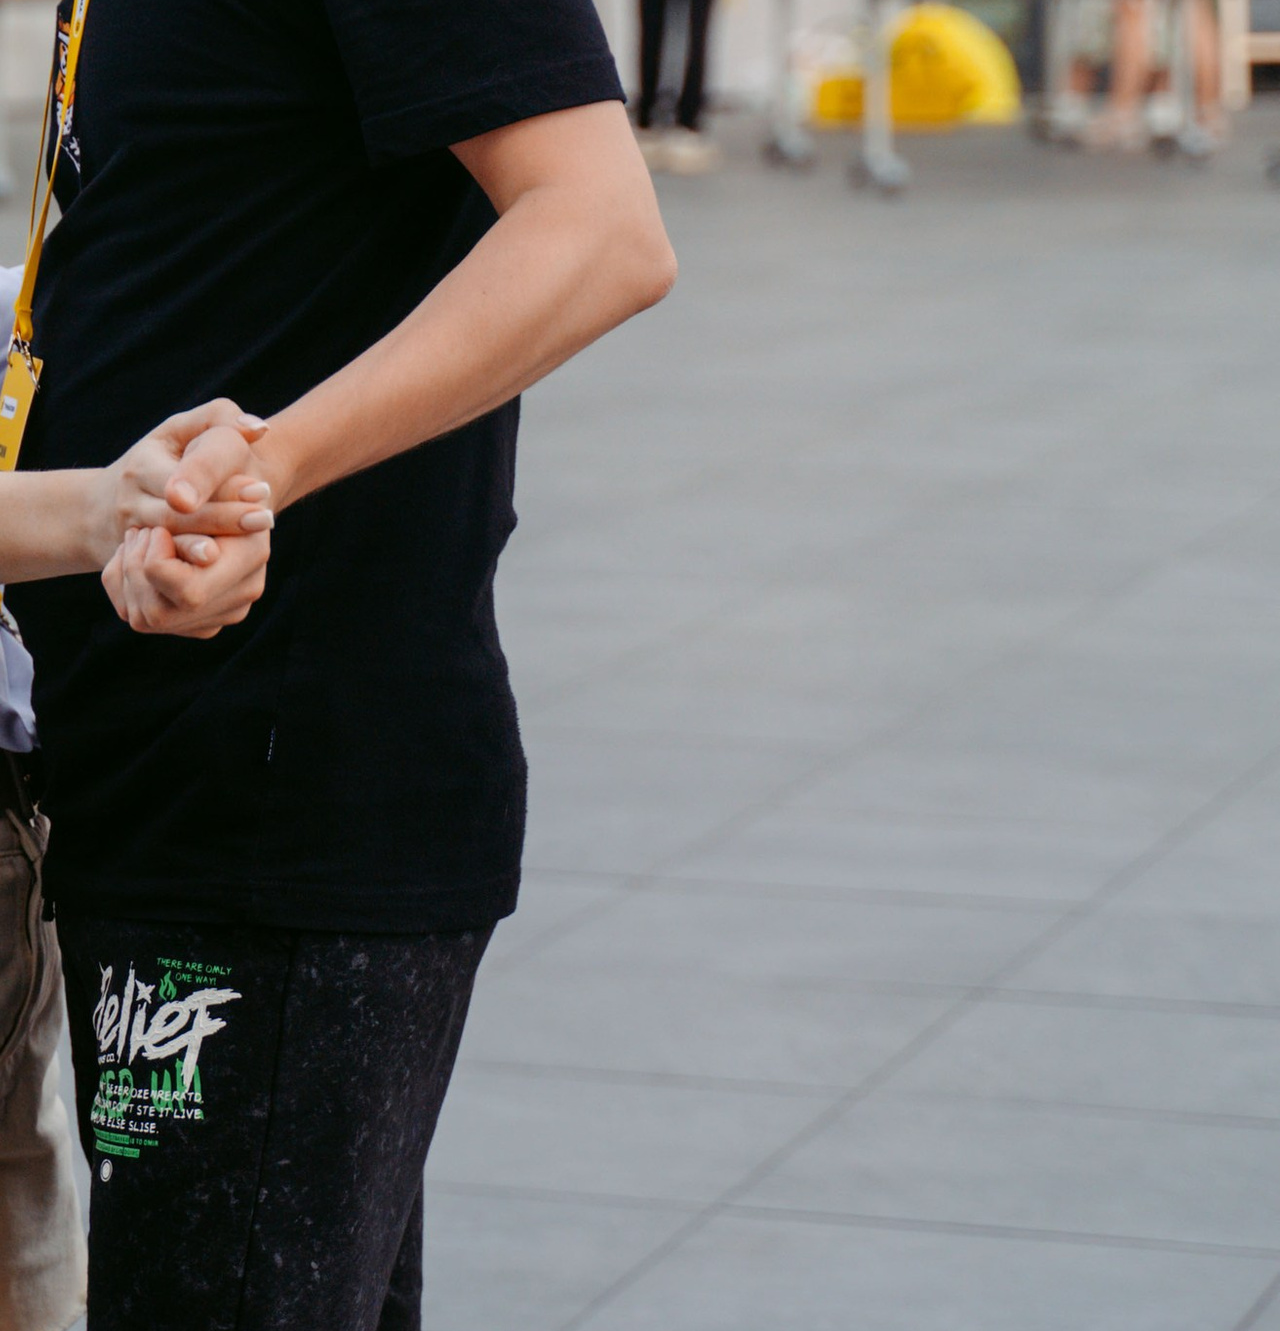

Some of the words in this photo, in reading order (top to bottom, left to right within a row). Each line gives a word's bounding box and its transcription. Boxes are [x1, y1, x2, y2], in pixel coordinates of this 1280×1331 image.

[156, 957, 183, 969] THERE
[185, 961, 203, 972] ARE
[175, 972, 193, 983] ONE
[195, 976, 217, 986] WAY!
[173, 1108, 202, 1120] LIVE
